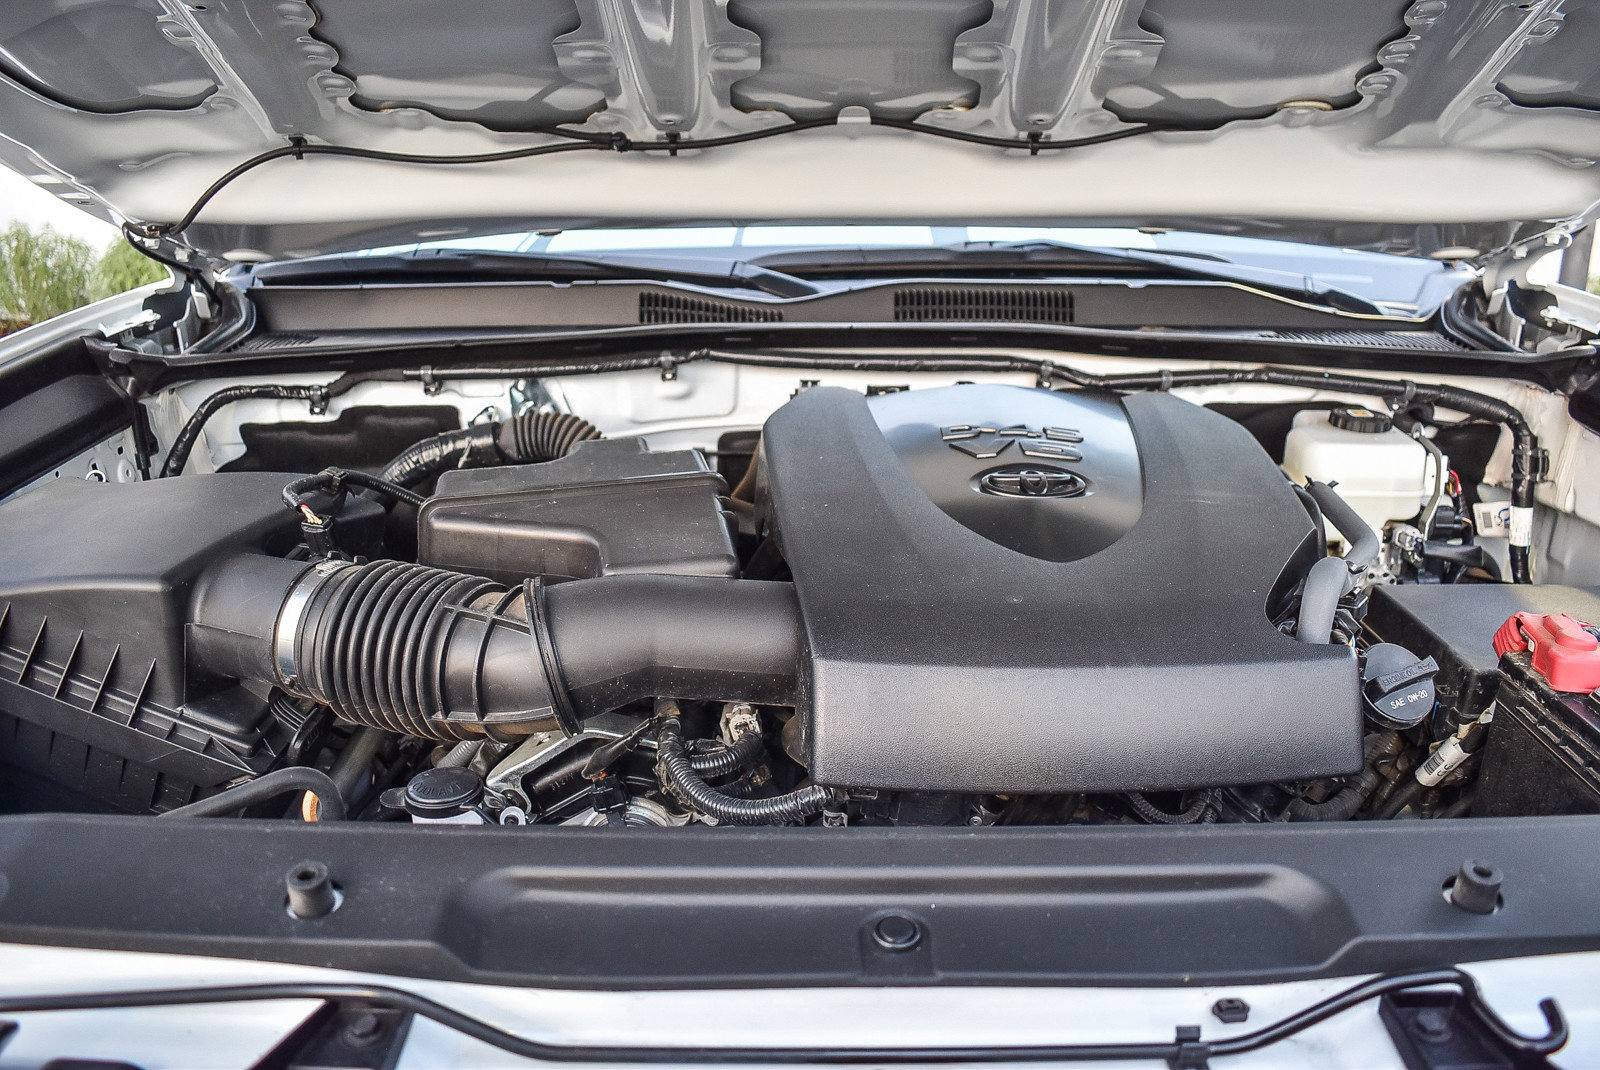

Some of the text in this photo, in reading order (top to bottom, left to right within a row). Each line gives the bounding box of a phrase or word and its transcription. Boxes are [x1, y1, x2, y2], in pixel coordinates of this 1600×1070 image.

[948, 438, 1083, 462] V6
[1390, 689, 1428, 710] SAE 0W-20
